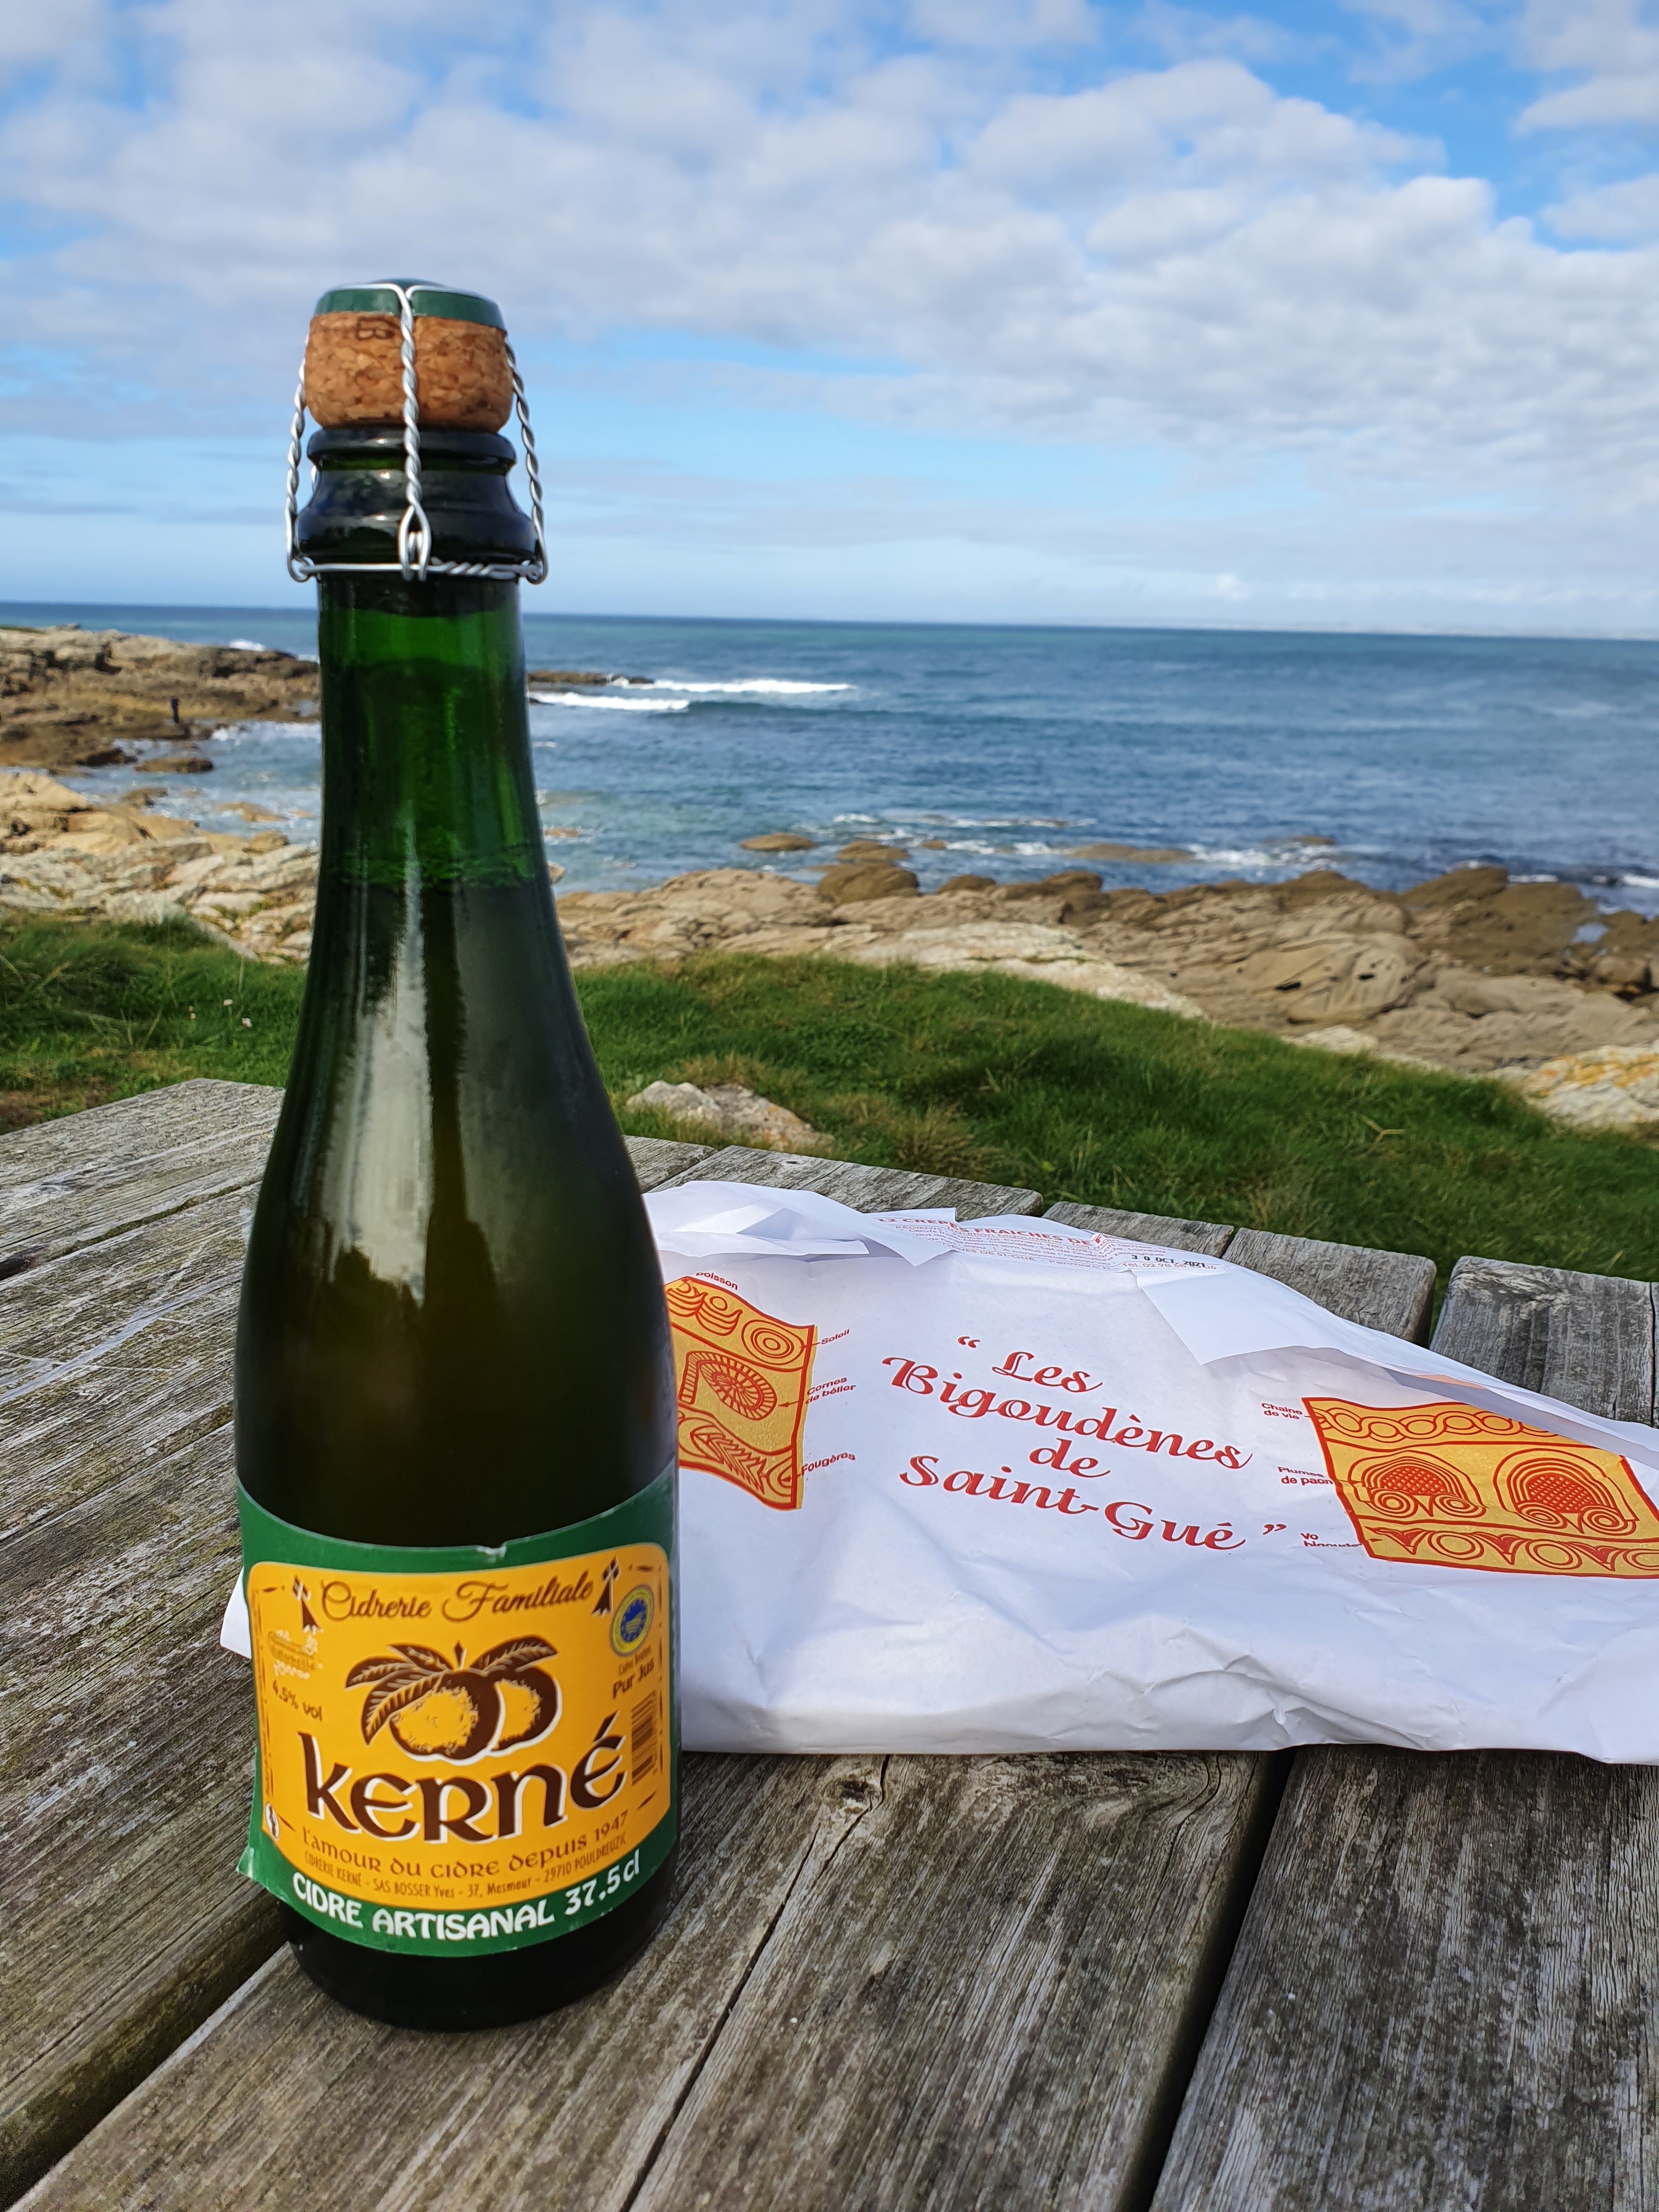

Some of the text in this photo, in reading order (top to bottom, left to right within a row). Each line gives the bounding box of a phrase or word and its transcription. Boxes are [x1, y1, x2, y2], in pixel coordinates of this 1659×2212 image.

[974, 1228, 1063, 1241] FRAICHES
[1067, 1238, 1093, 1246] DE
[696, 1272, 738, 1290] poisson
[821, 1328, 850, 1345] Soleil
[991, 1351, 1103, 1393] Les
[806, 1377, 848, 1395] Cornes
[805, 1394, 820, 1404] de
[882, 1357, 1253, 1470] Bigoudènes
[801, 1452, 856, 1477] Fougères
[1029, 1438, 1111, 1478] de
[1277, 1466, 1325, 1478] Plumes
[1281, 1475, 1334, 1486] de paon
[899, 1455, 1246, 1551] Saint-Gué
[320, 1579, 432, 1622] Cidrerie
[441, 1569, 594, 1622] Familiale
[612, 1656, 655, 1700] Pur Jus
[302, 1701, 323, 1722] vol
[390, 1857, 421, 1877] du
[594, 1808, 628, 1842] 1947
[373, 1877, 392, 1893] SAS
[293, 1871, 364, 1929] CIDRE
[372, 1899, 555, 1941] ARTISANAL
